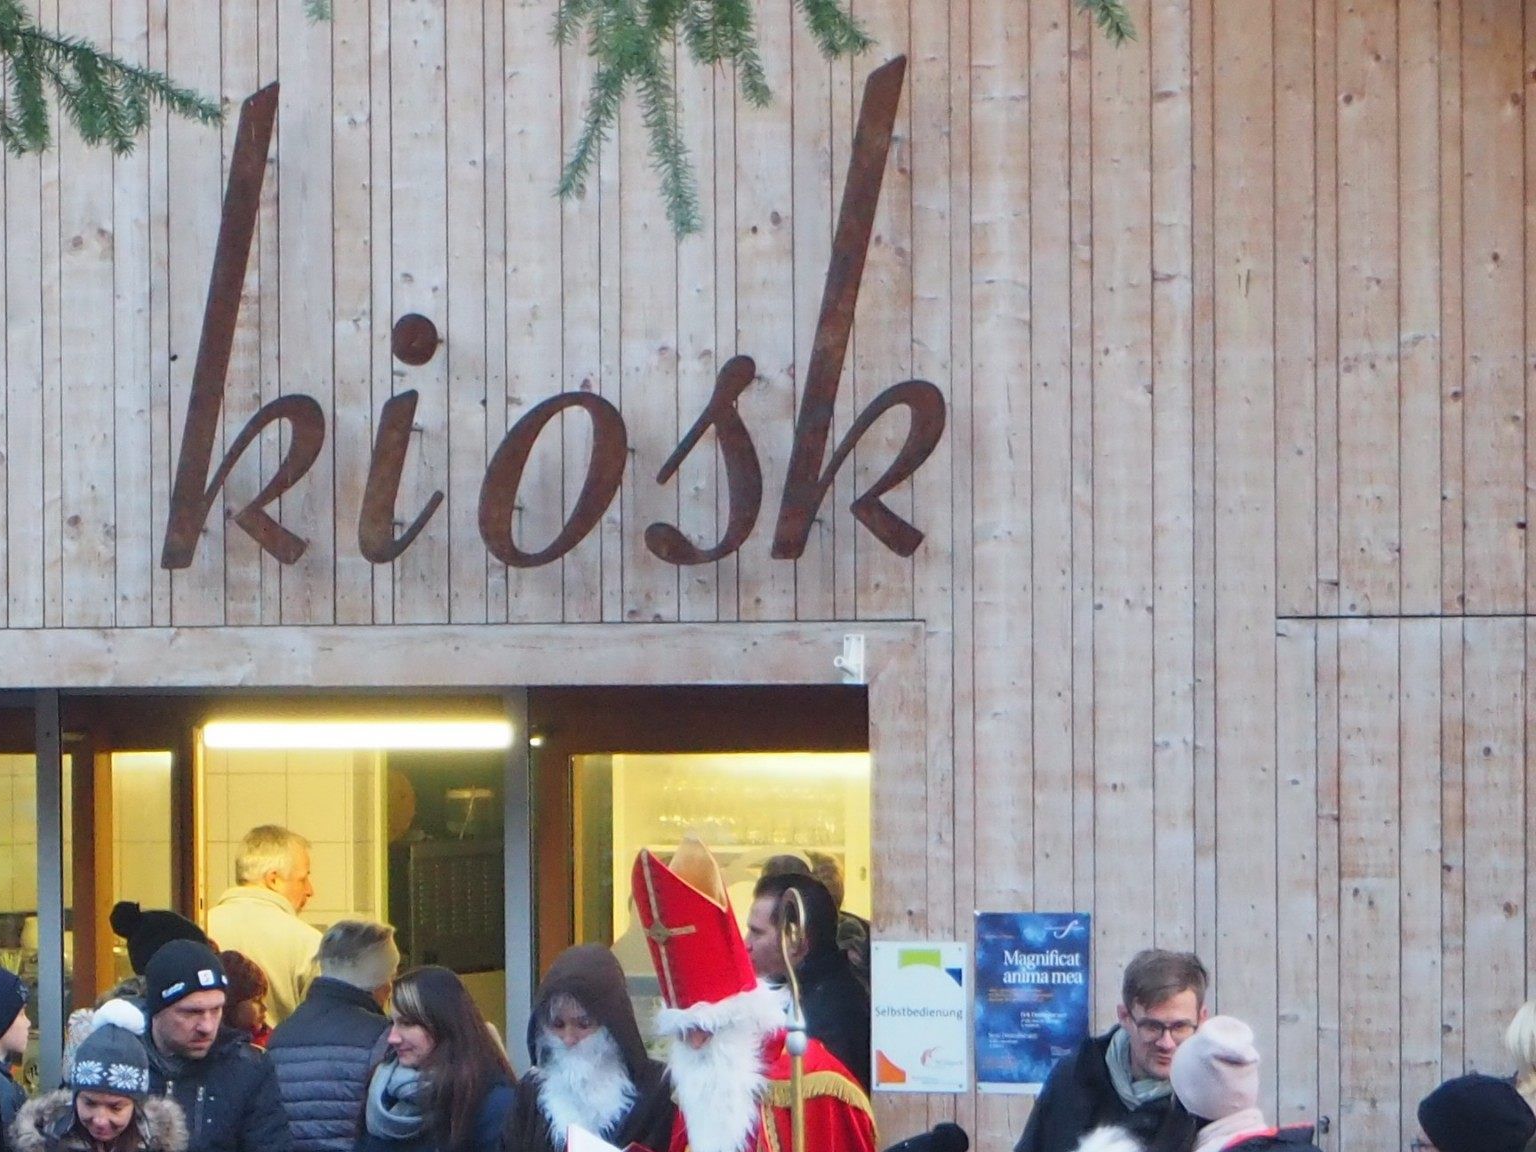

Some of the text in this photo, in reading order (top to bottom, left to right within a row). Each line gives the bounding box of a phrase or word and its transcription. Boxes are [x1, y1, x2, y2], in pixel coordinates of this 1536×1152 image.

[160, 54, 947, 569] kiosk
[1003, 949, 1081, 970] Magnificat
[1003, 970, 1084, 985] anima mea
[875, 1005, 963, 1021] Selbstbedienung
